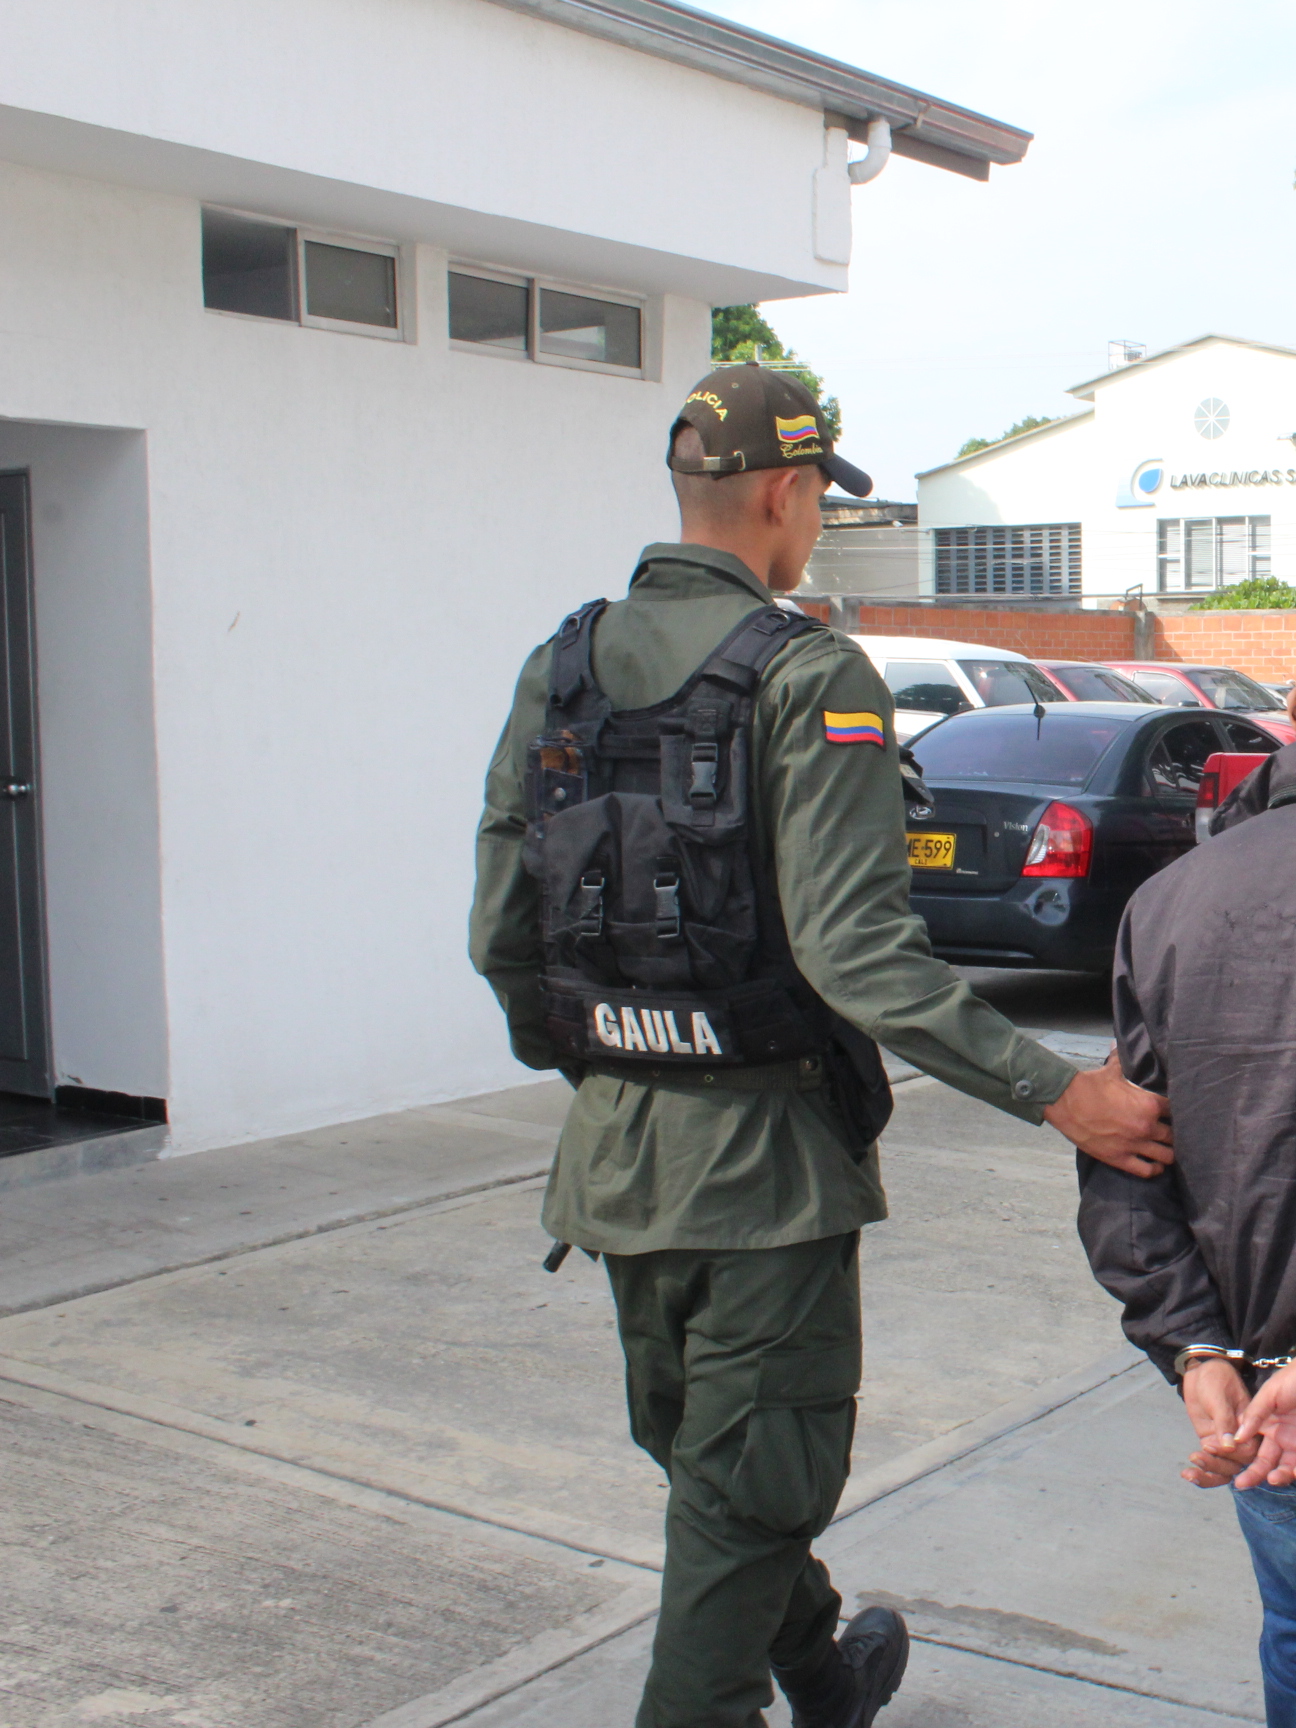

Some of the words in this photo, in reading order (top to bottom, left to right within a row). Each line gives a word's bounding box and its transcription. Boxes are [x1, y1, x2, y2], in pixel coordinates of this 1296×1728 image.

[686, 391, 728, 421] OLICIA
[1169, 470, 1283, 488] LAVACLINICAS
[594, 1002, 722, 1055] GAULA
